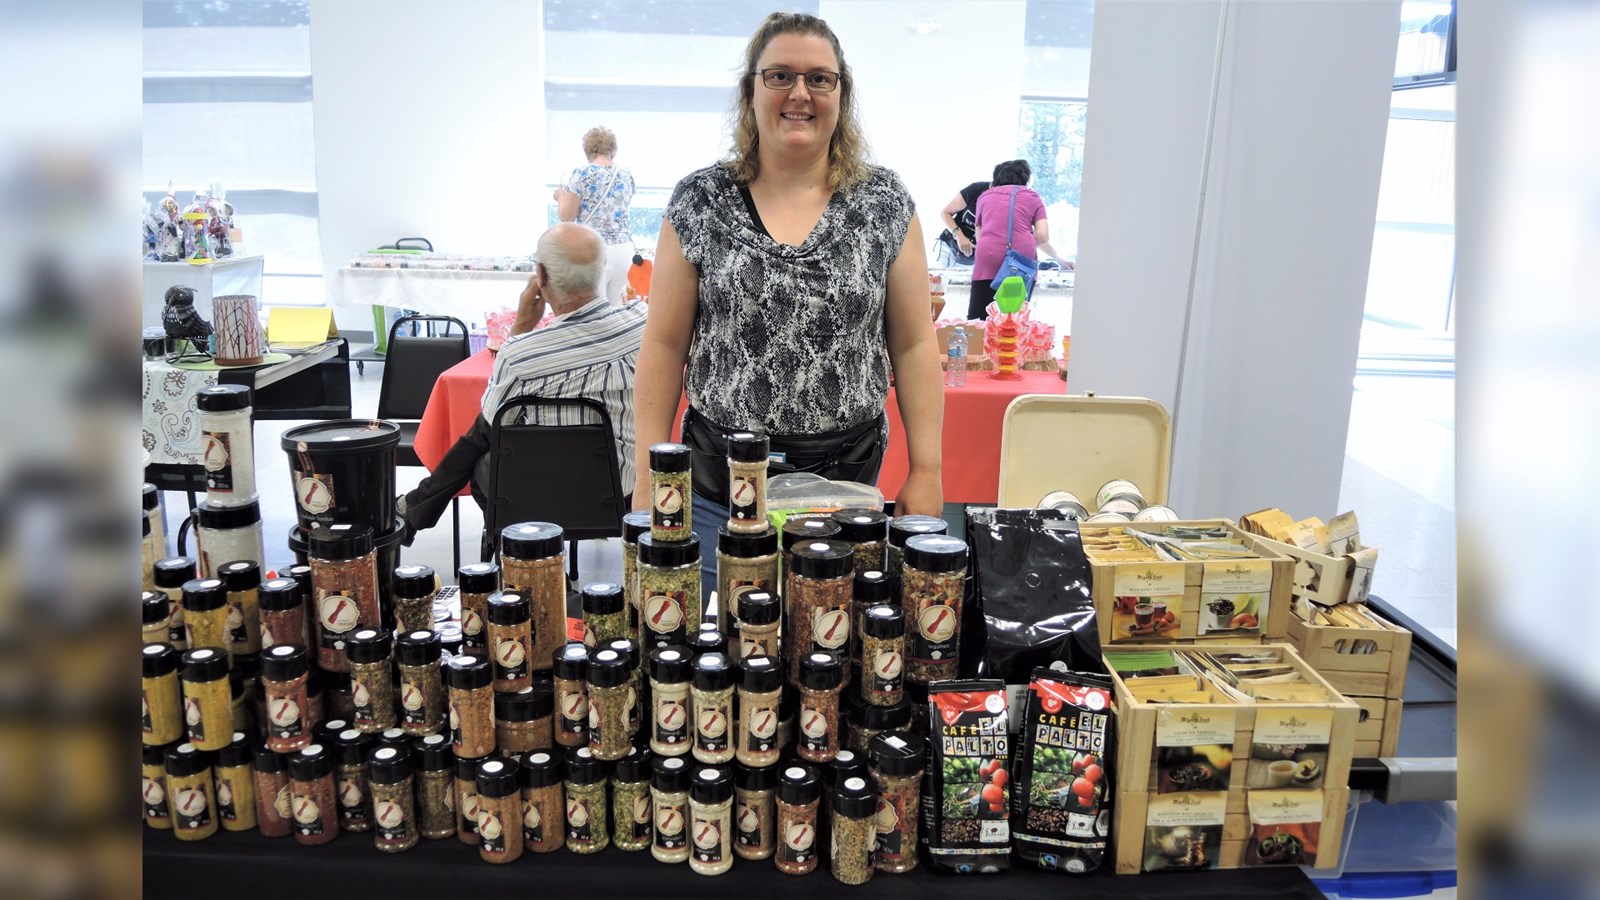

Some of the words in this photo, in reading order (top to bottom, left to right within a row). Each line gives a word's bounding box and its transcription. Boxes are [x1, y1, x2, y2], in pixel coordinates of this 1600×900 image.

[1039, 714, 1077, 728] CAFÉ
[1080, 714, 1105, 731] EL
[944, 739, 1006, 753] PALTO
[1038, 726, 1103, 749] PALTO
